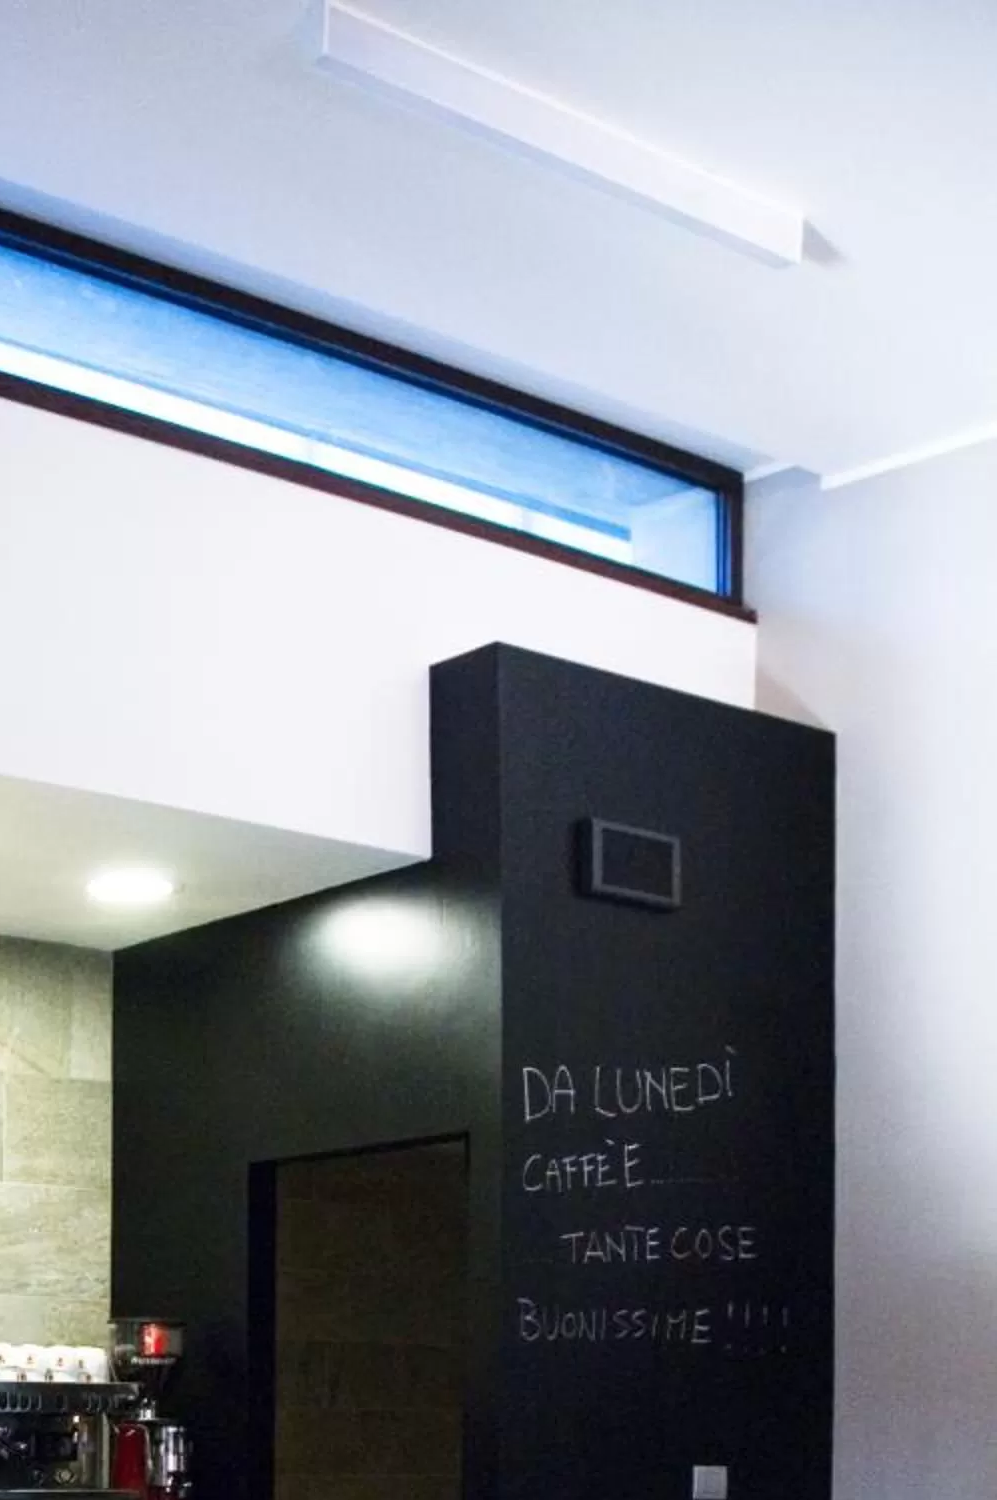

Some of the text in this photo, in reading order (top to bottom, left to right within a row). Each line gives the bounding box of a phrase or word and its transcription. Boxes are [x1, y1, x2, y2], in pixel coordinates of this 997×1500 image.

[521, 1044, 738, 1124] DA LUNEDÌ
[521, 1138, 618, 1193] CAFFÈ
[559, 1225, 758, 1264] TANTE COSE
